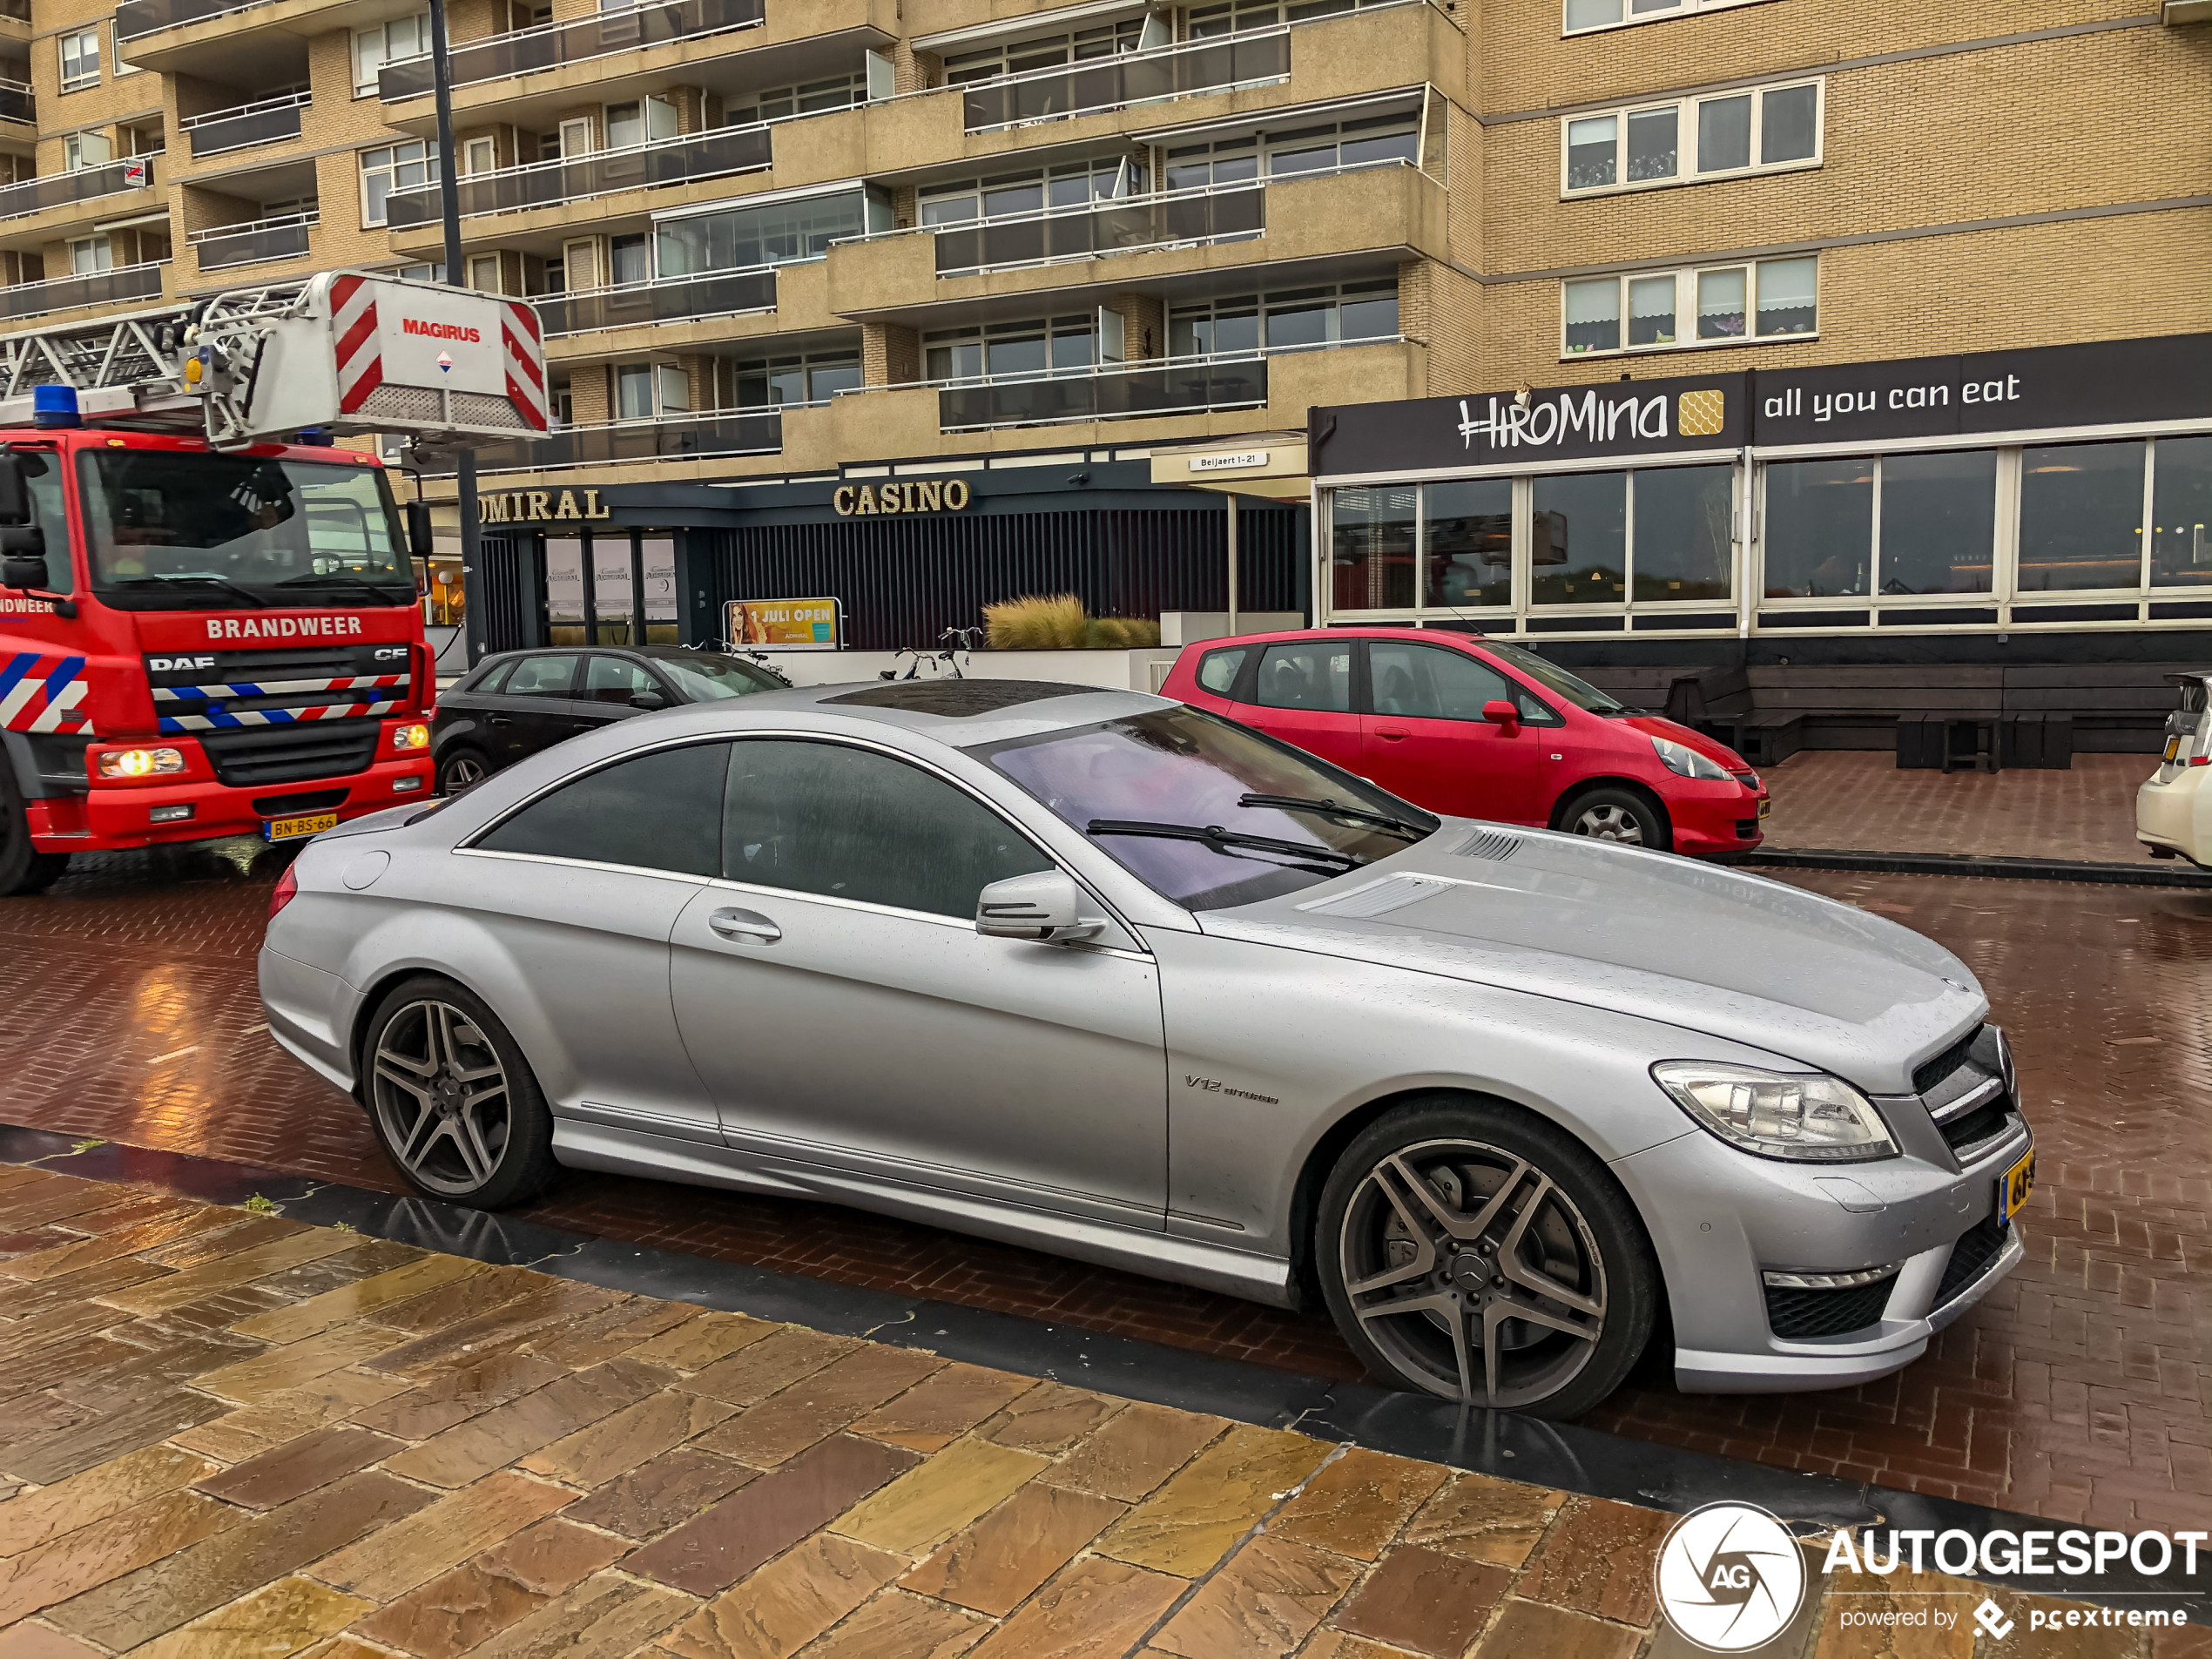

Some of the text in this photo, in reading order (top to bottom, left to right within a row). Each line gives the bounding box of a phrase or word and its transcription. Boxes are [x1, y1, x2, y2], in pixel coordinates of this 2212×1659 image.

[403, 318, 480, 343] MAGIRUS
[1764, 374, 2020, 421] all you can eat
[1201, 457, 1235, 468] Beijaert
[833, 479, 969, 516] CASINO
[751, 609, 831, 623] 1 JULI OPEN
[206, 617, 361, 638] BRANDWEER
[149, 657, 215, 671] DAF
[374, 648, 408, 661] CF
[275, 817, 333, 835] BN-BS-66
[1185, 1074, 1278, 1104] V12 BITURBO
